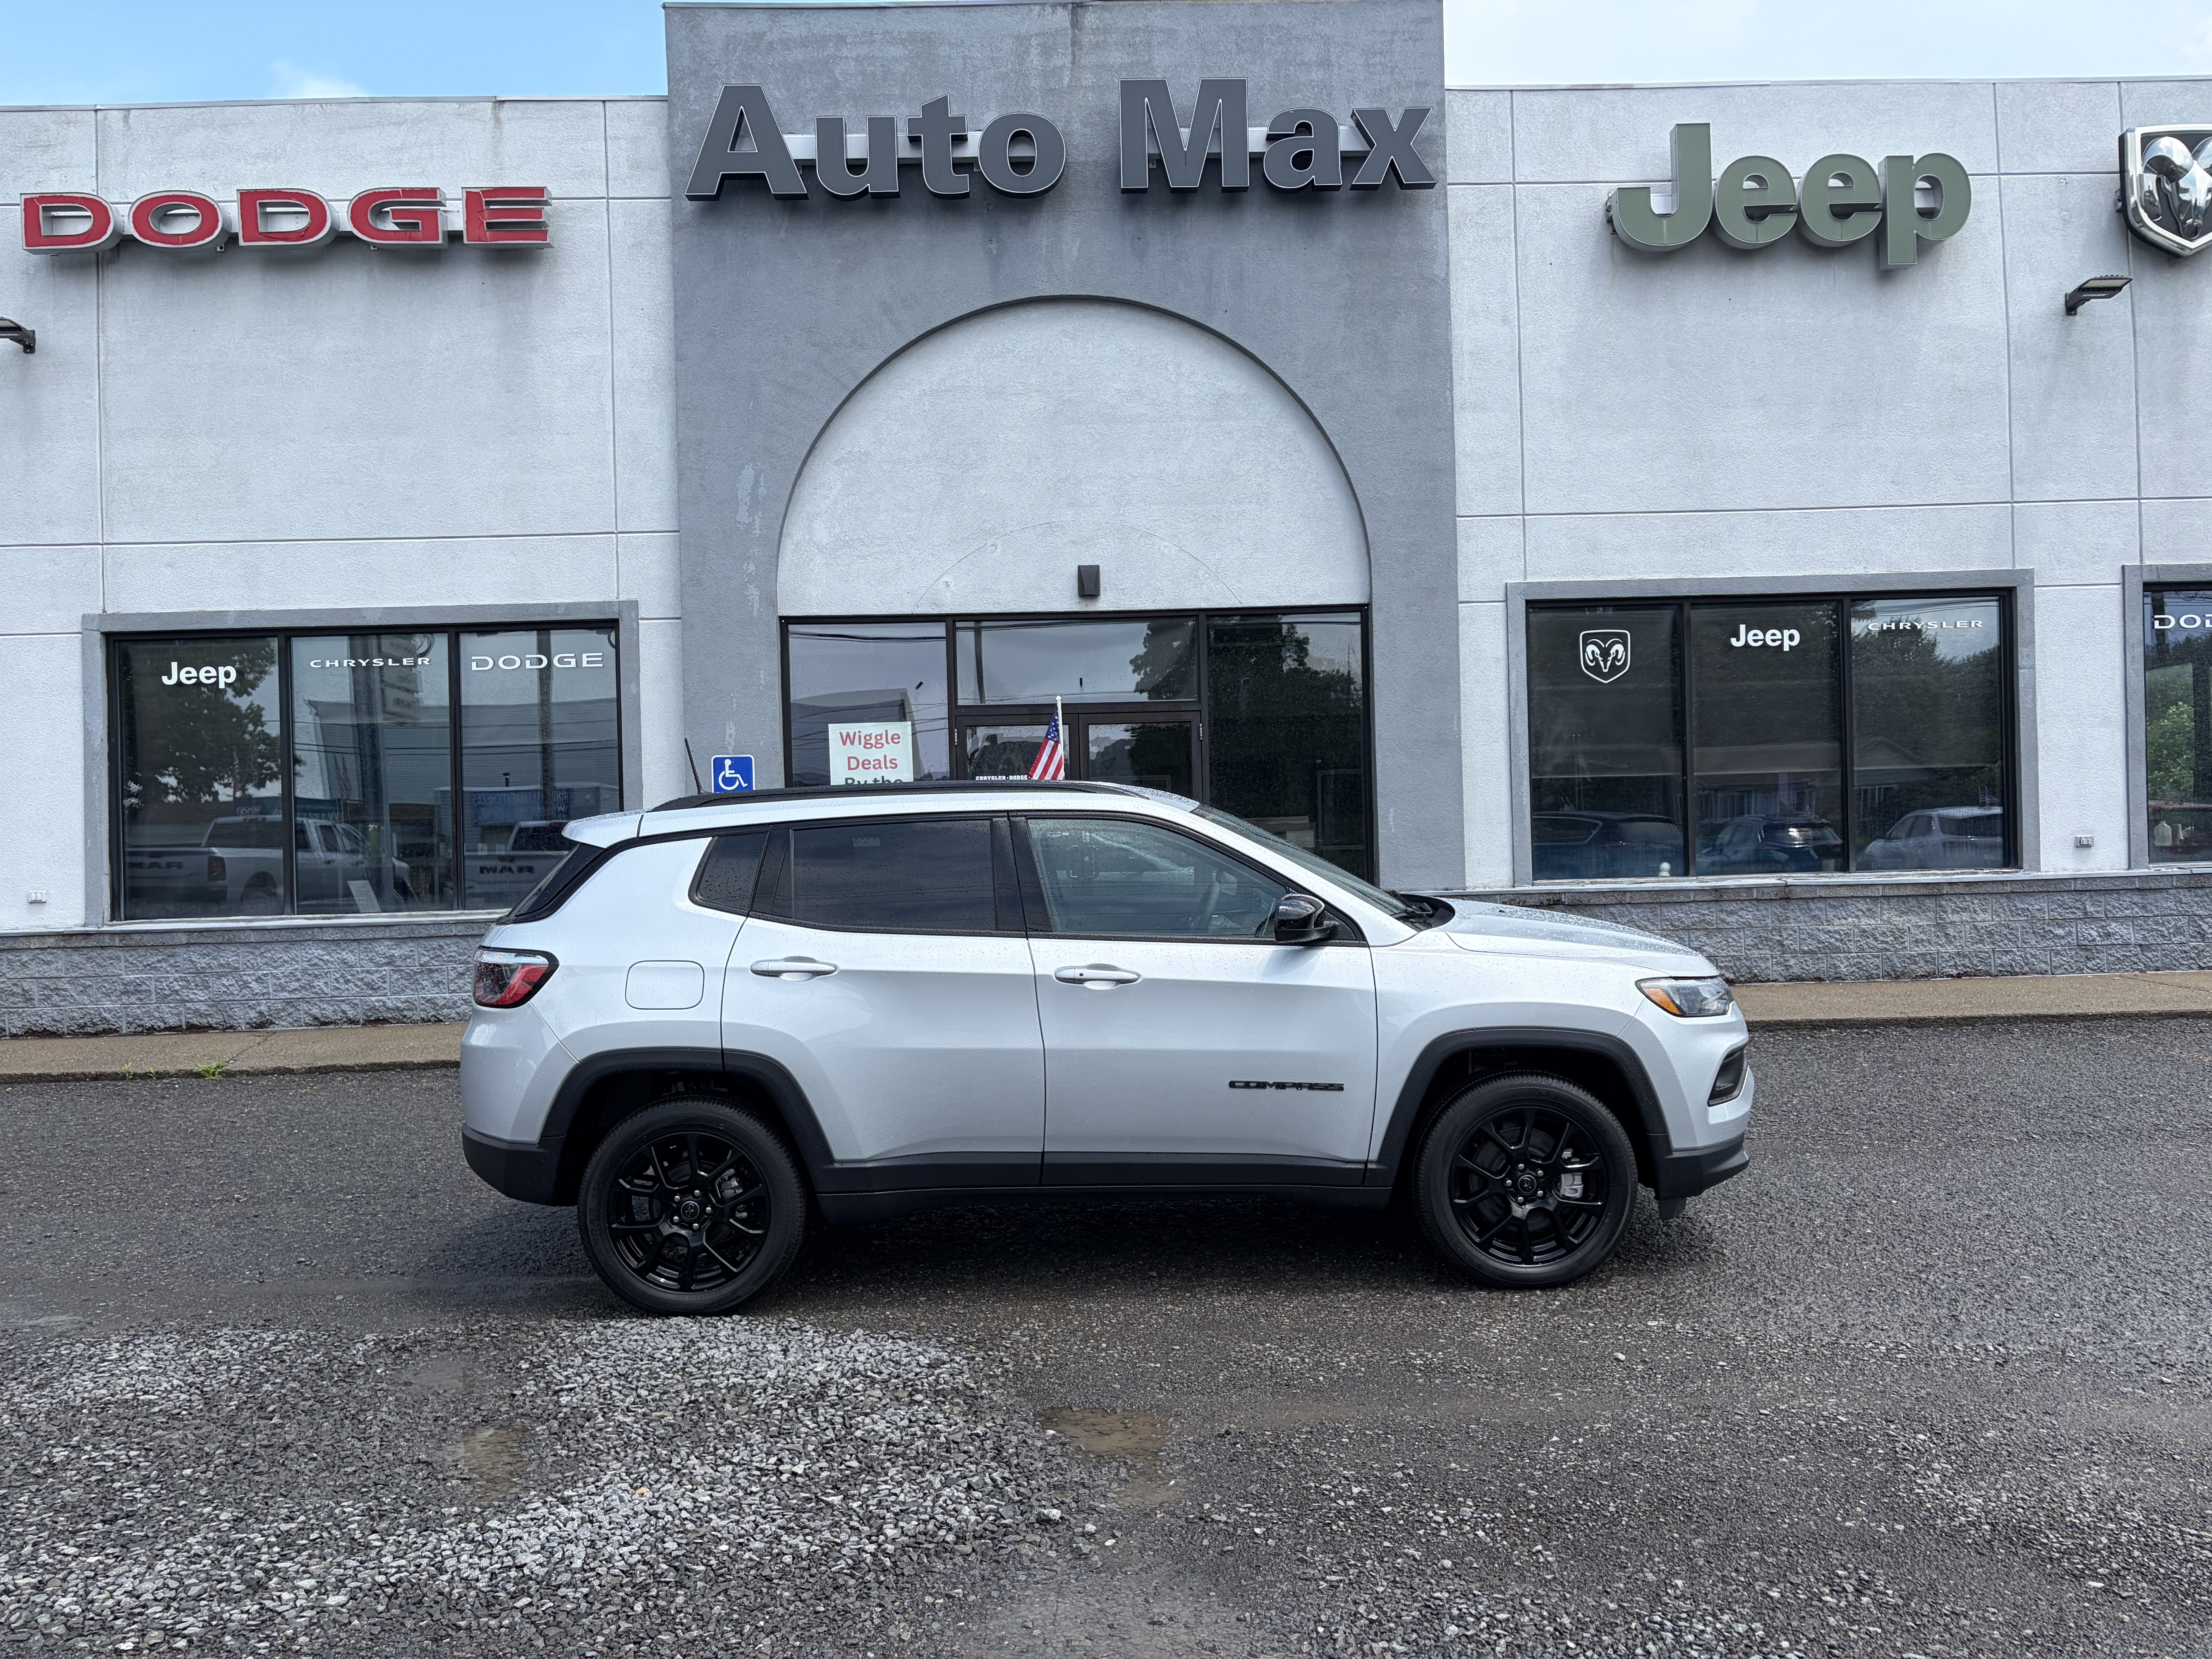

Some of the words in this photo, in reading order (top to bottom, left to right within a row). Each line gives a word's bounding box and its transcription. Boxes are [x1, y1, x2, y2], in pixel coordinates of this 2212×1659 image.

[685, 83, 1066, 199] Auto
[1118, 77, 1437, 190] Max
[1615, 122, 1972, 267] Jeep
[20, 186, 551, 251] DODGE
[1868, 620, 1983, 631] CHRYSLER
[1730, 624, 1800, 651] Jeep
[309, 657, 430, 668] CHRYSLER
[472, 652, 603, 671] DODGE
[161, 661, 237, 689] Jeep
[839, 730, 901, 750] Wiggle
[847, 754, 898, 771] Deals
[1228, 1080, 1345, 1092] COMPASS
